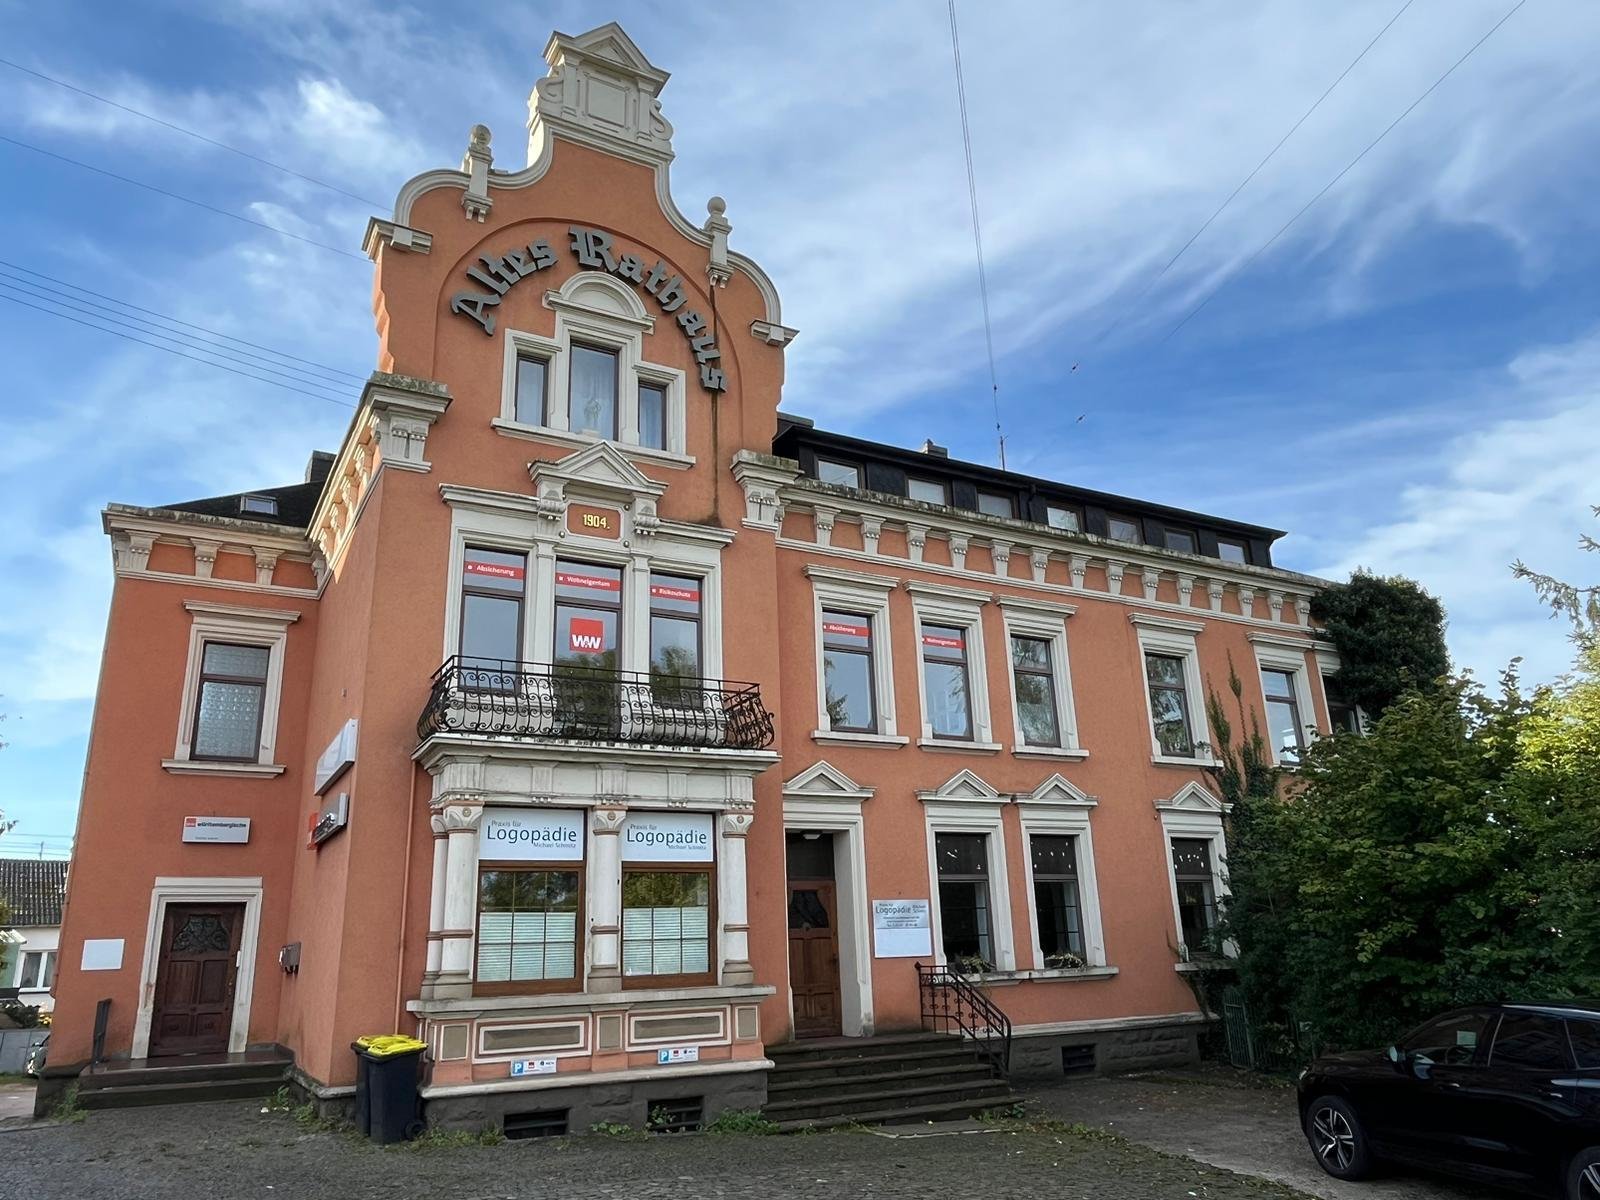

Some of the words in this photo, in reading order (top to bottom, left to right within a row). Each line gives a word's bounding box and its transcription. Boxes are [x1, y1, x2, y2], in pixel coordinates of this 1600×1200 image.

[451, 236, 559, 337] Altes
[567, 224, 728, 394] Rathaus
[476, 564, 515, 577] Absicherung
[567, 575, 611, 588] Wohneigentum
[491, 820, 511, 828] Praxis
[513, 820, 522, 828] für
[630, 823, 648, 831] Praxis
[487, 825, 577, 845] Logopädie
[627, 828, 707, 847] Logopädie
[514, 1063, 522, 1073] P
